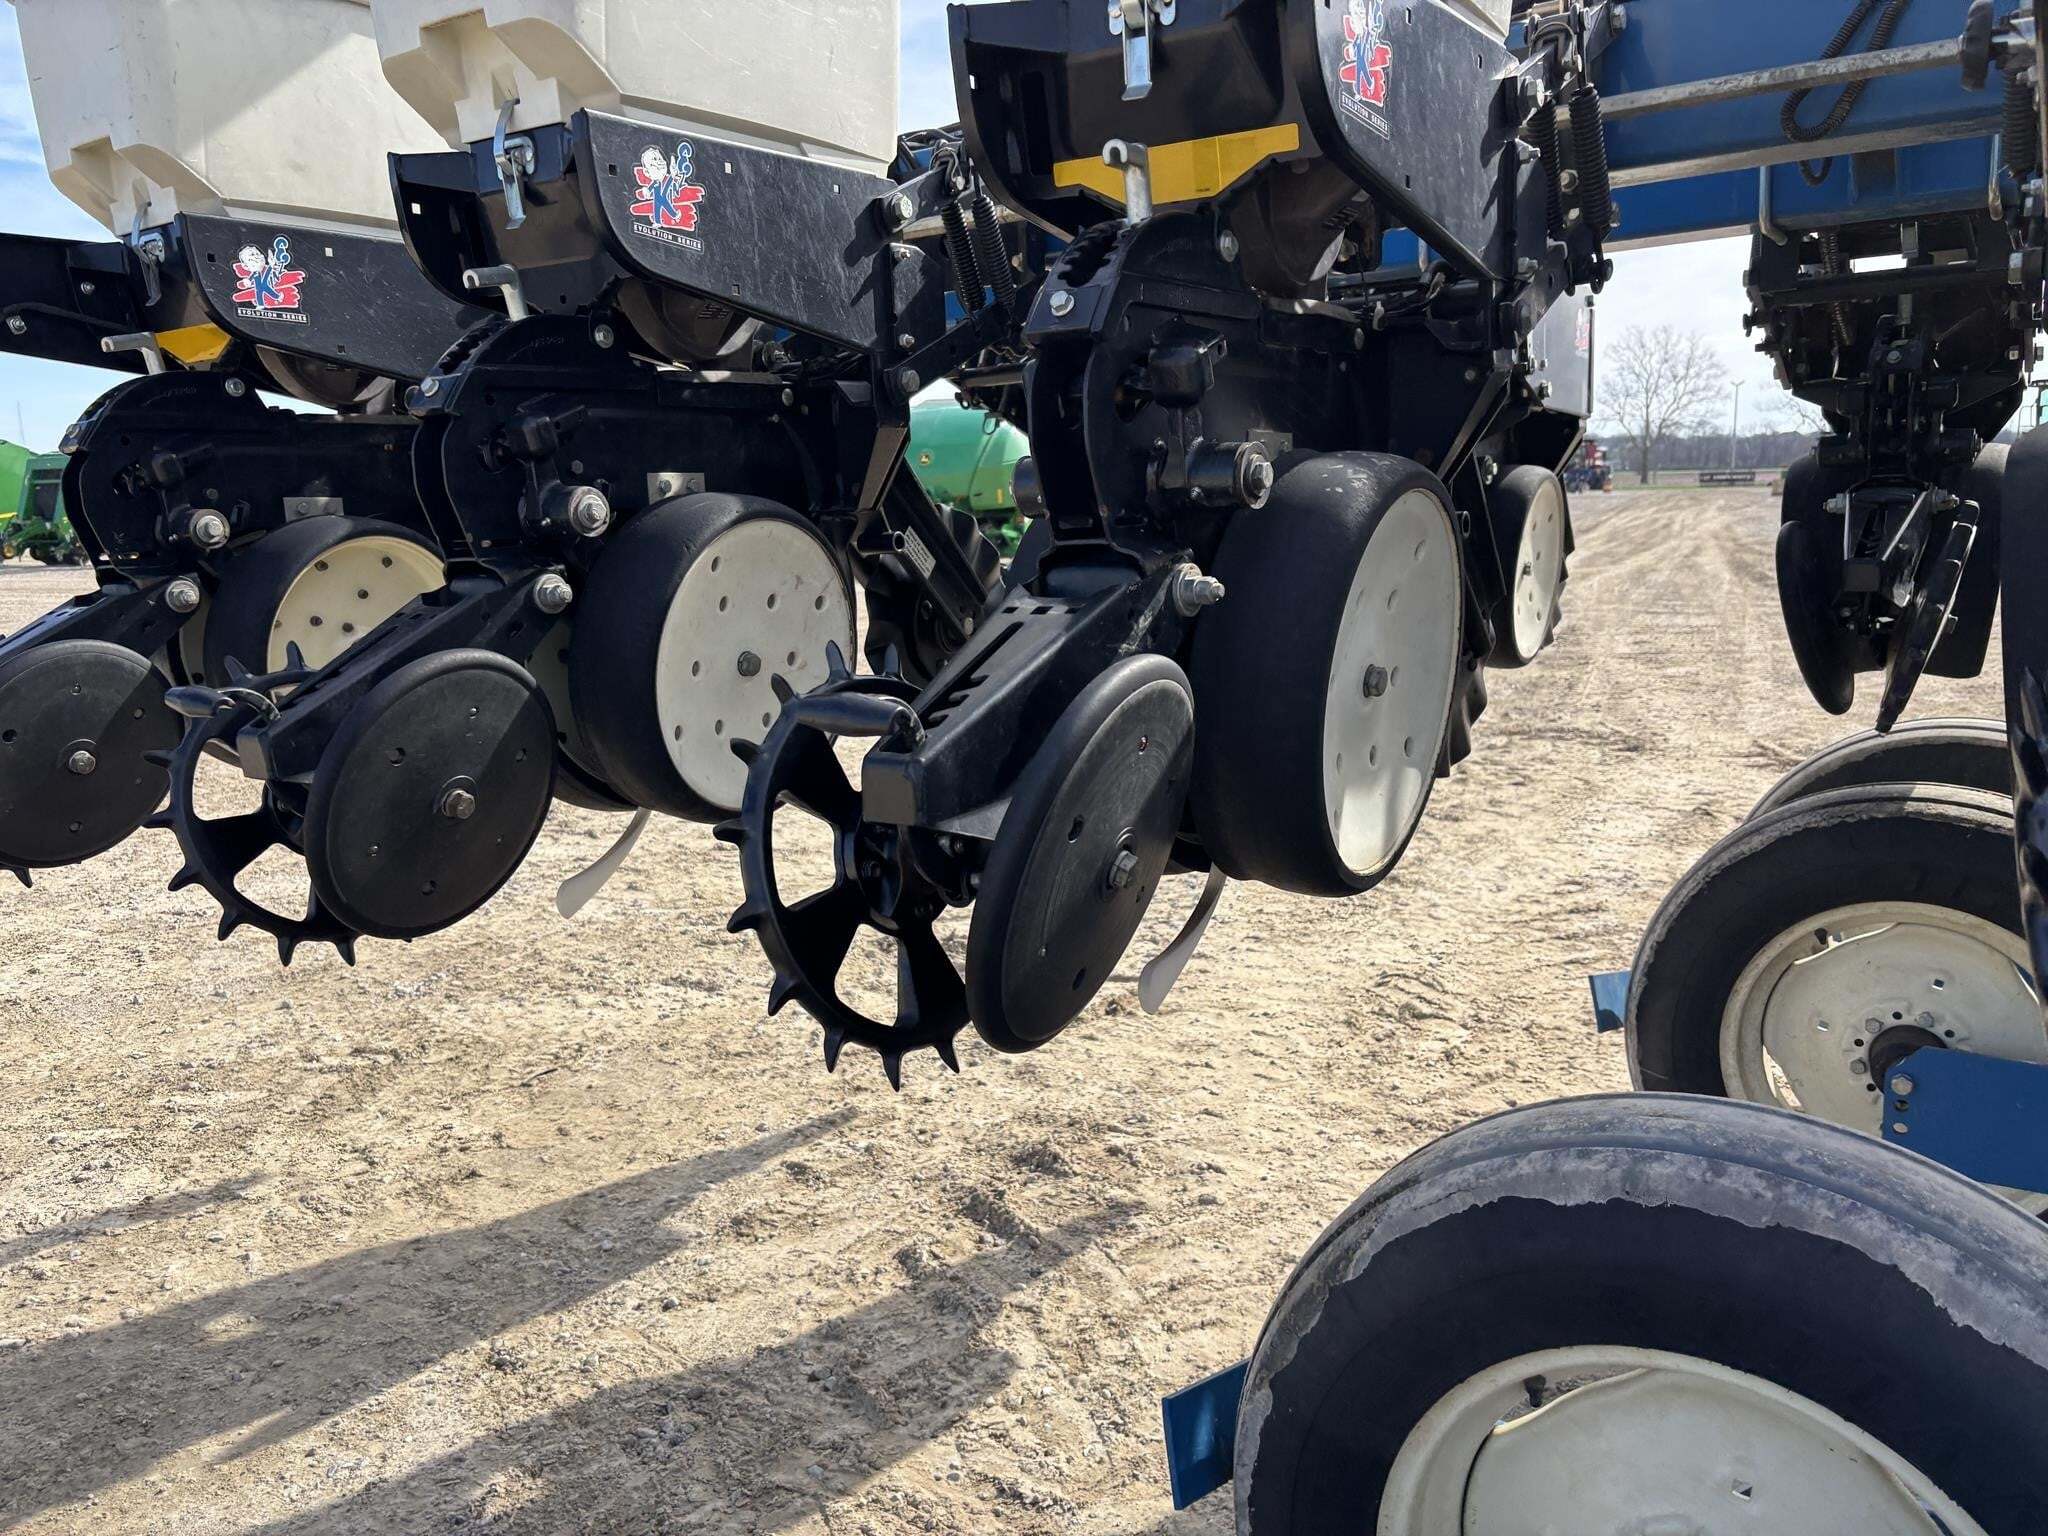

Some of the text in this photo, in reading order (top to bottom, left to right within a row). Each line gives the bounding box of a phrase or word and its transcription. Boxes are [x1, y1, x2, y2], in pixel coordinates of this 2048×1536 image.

[634, 224, 702, 249] EVOLUTION SERIES
[237, 307, 307, 321] EVOLUTION SERIES
